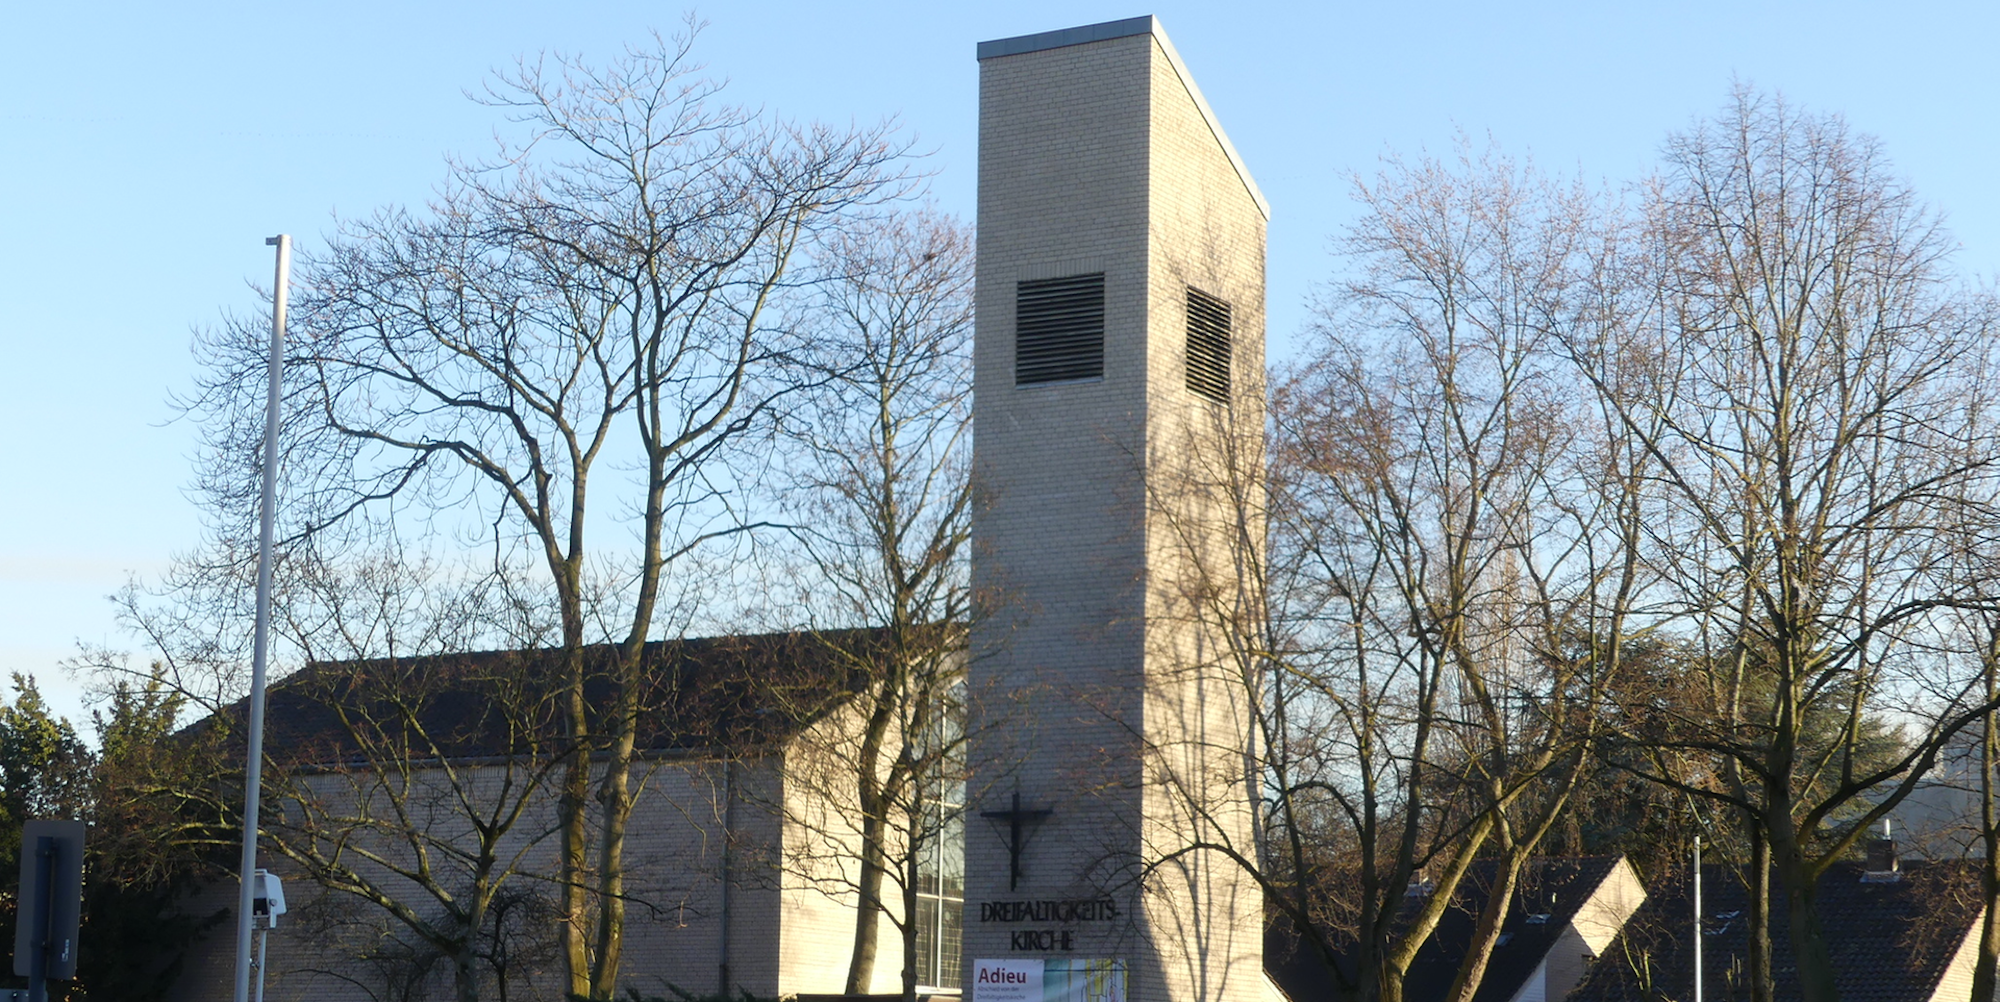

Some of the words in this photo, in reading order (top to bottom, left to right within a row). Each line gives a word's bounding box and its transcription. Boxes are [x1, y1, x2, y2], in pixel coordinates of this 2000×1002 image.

[980, 901, 1122, 922] DREIFALTIGKEITS-
[1011, 930, 1074, 951] KIRCHE
[978, 967, 1026, 984] Adieu
